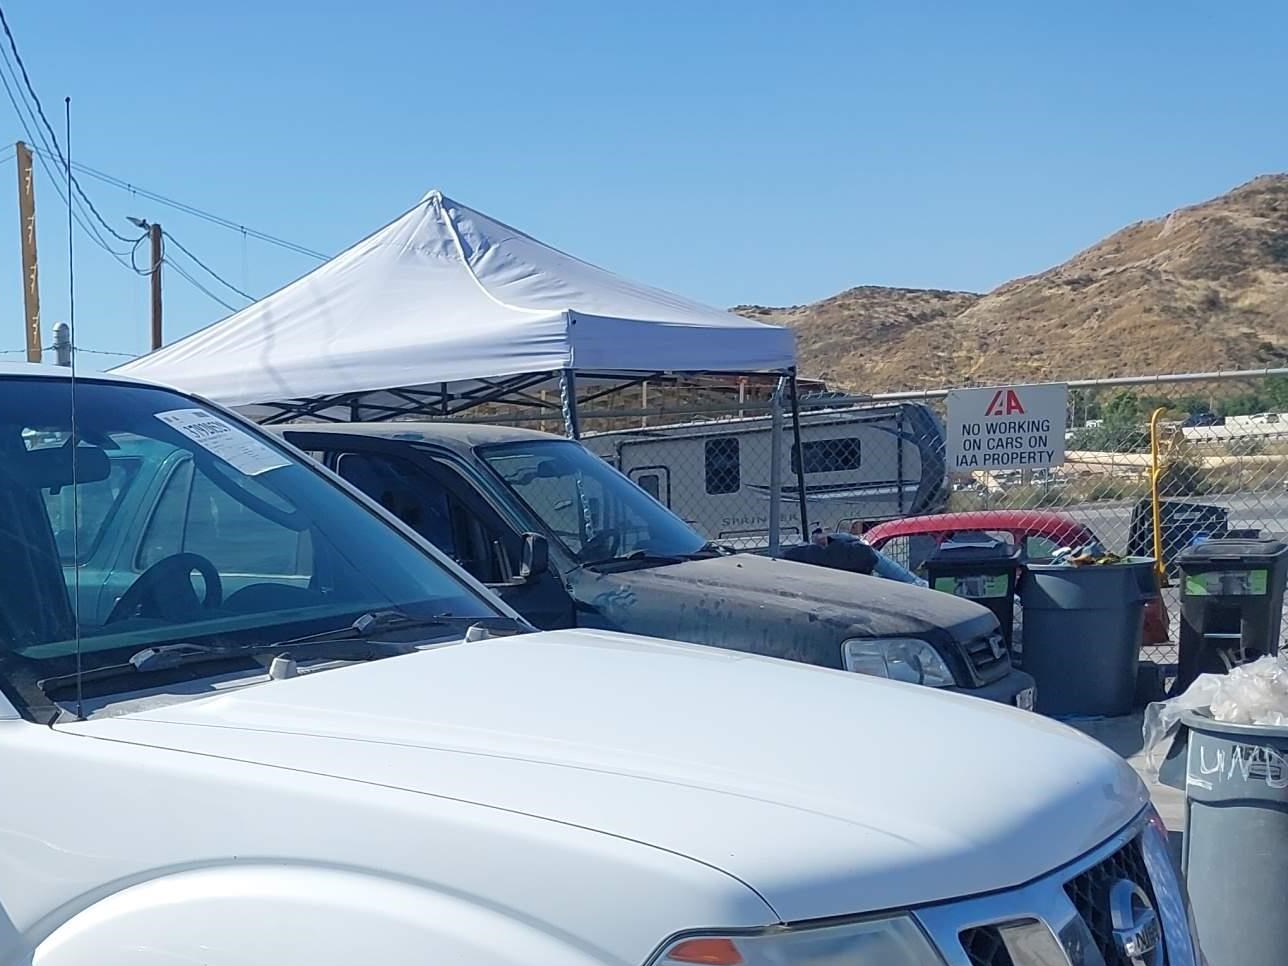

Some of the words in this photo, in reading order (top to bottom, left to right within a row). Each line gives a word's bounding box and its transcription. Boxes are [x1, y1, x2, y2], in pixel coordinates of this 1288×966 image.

[962, 424, 981, 436] NO
[985, 420, 1050, 435] WORKING
[963, 439, 981, 451] ON
[987, 437, 1023, 450] CARS
[1028, 436, 1048, 448] ON
[956, 454, 978, 467] IAA
[983, 450, 1055, 466] PROPERTY
[721, 512, 799, 527] SPRINER
